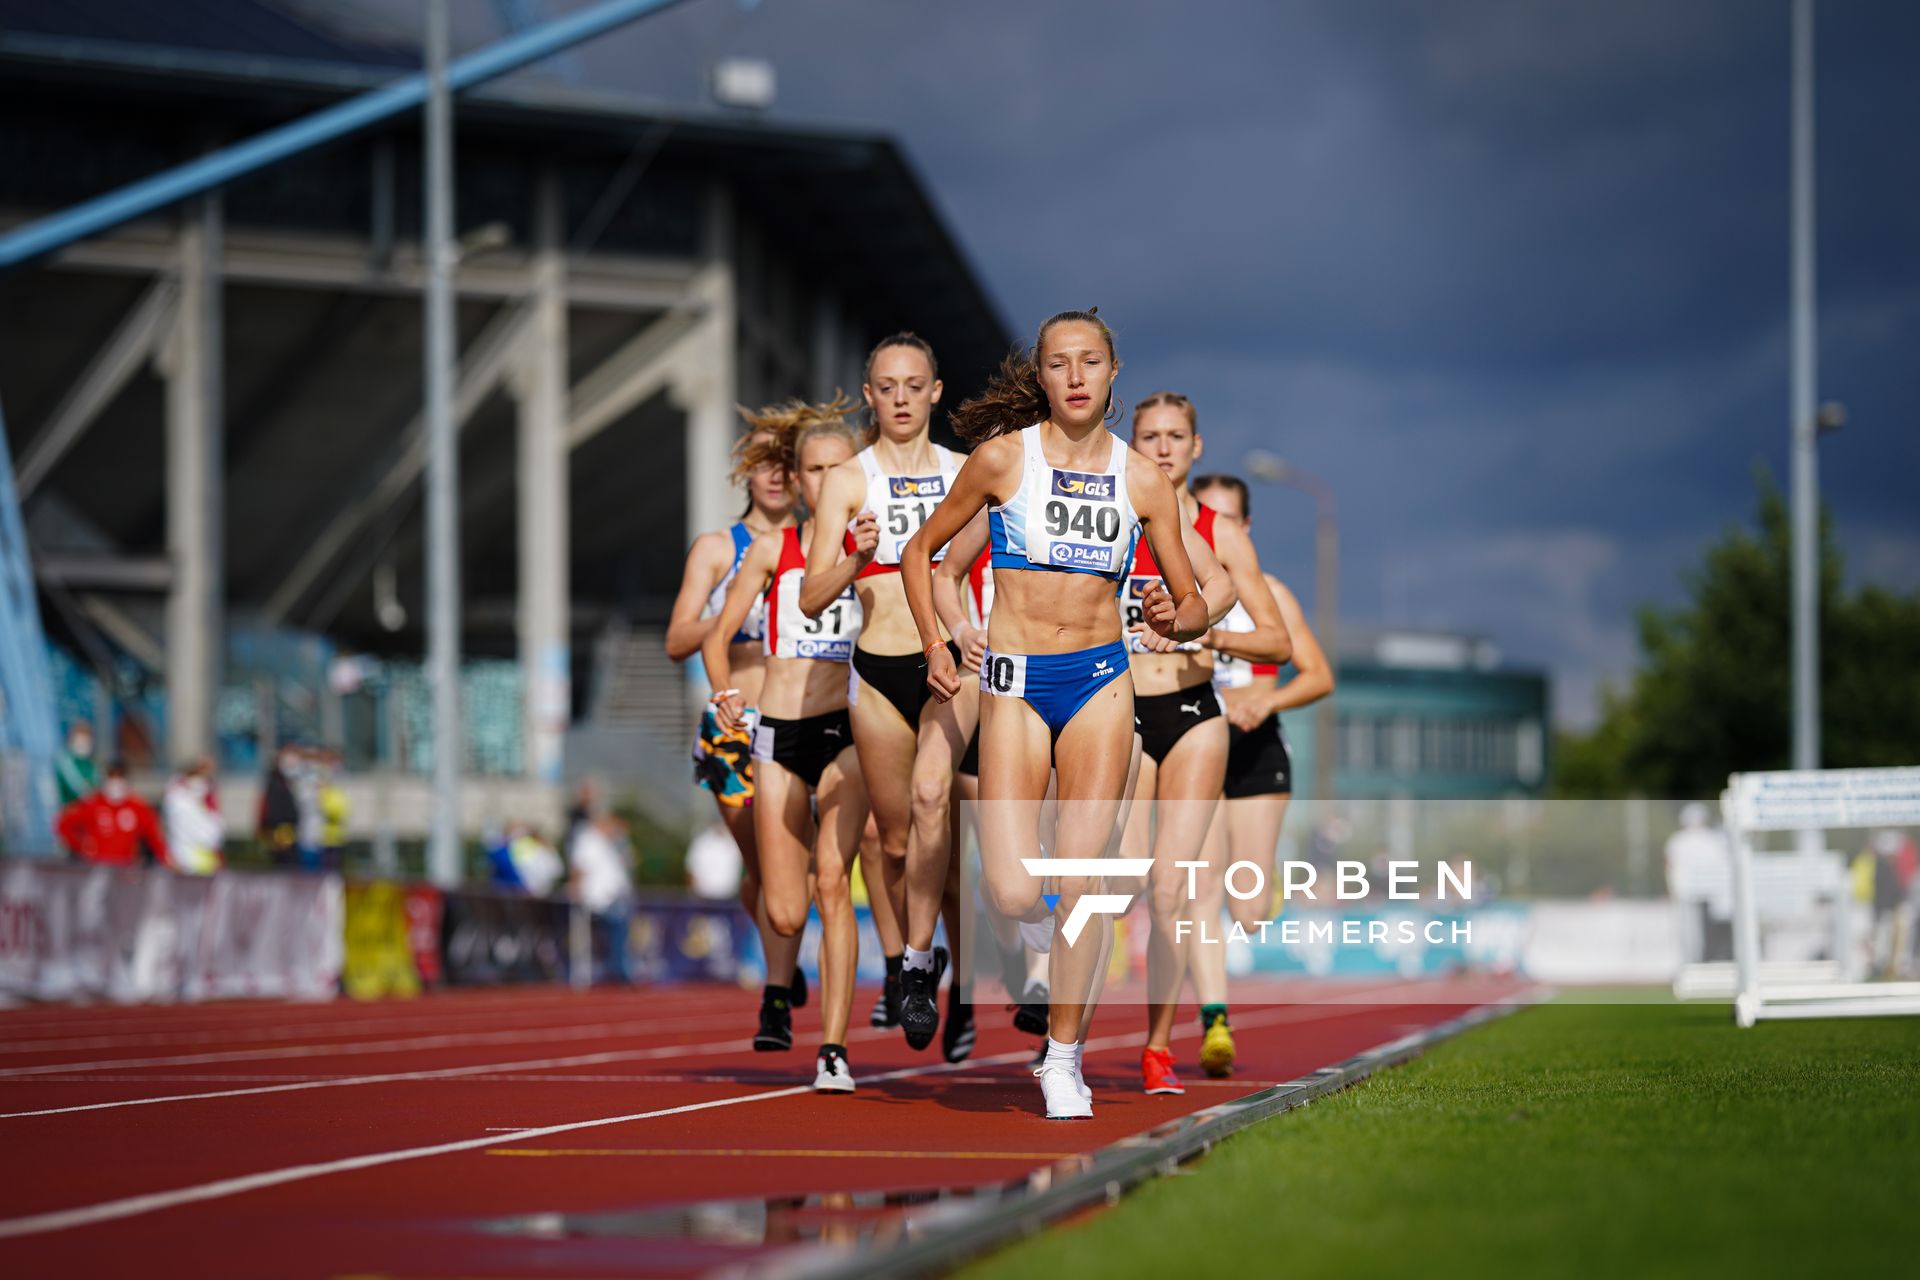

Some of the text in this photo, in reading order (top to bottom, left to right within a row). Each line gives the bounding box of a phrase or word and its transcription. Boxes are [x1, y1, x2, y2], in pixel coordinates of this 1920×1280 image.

[918, 480, 941, 495] GLS
[1084, 482, 1110, 496] GLS
[887, 502, 941, 535] 51
[1045, 500, 1120, 542] 940
[1074, 547, 1109, 561] PLAN
[1092, 667, 1114, 678] erima
